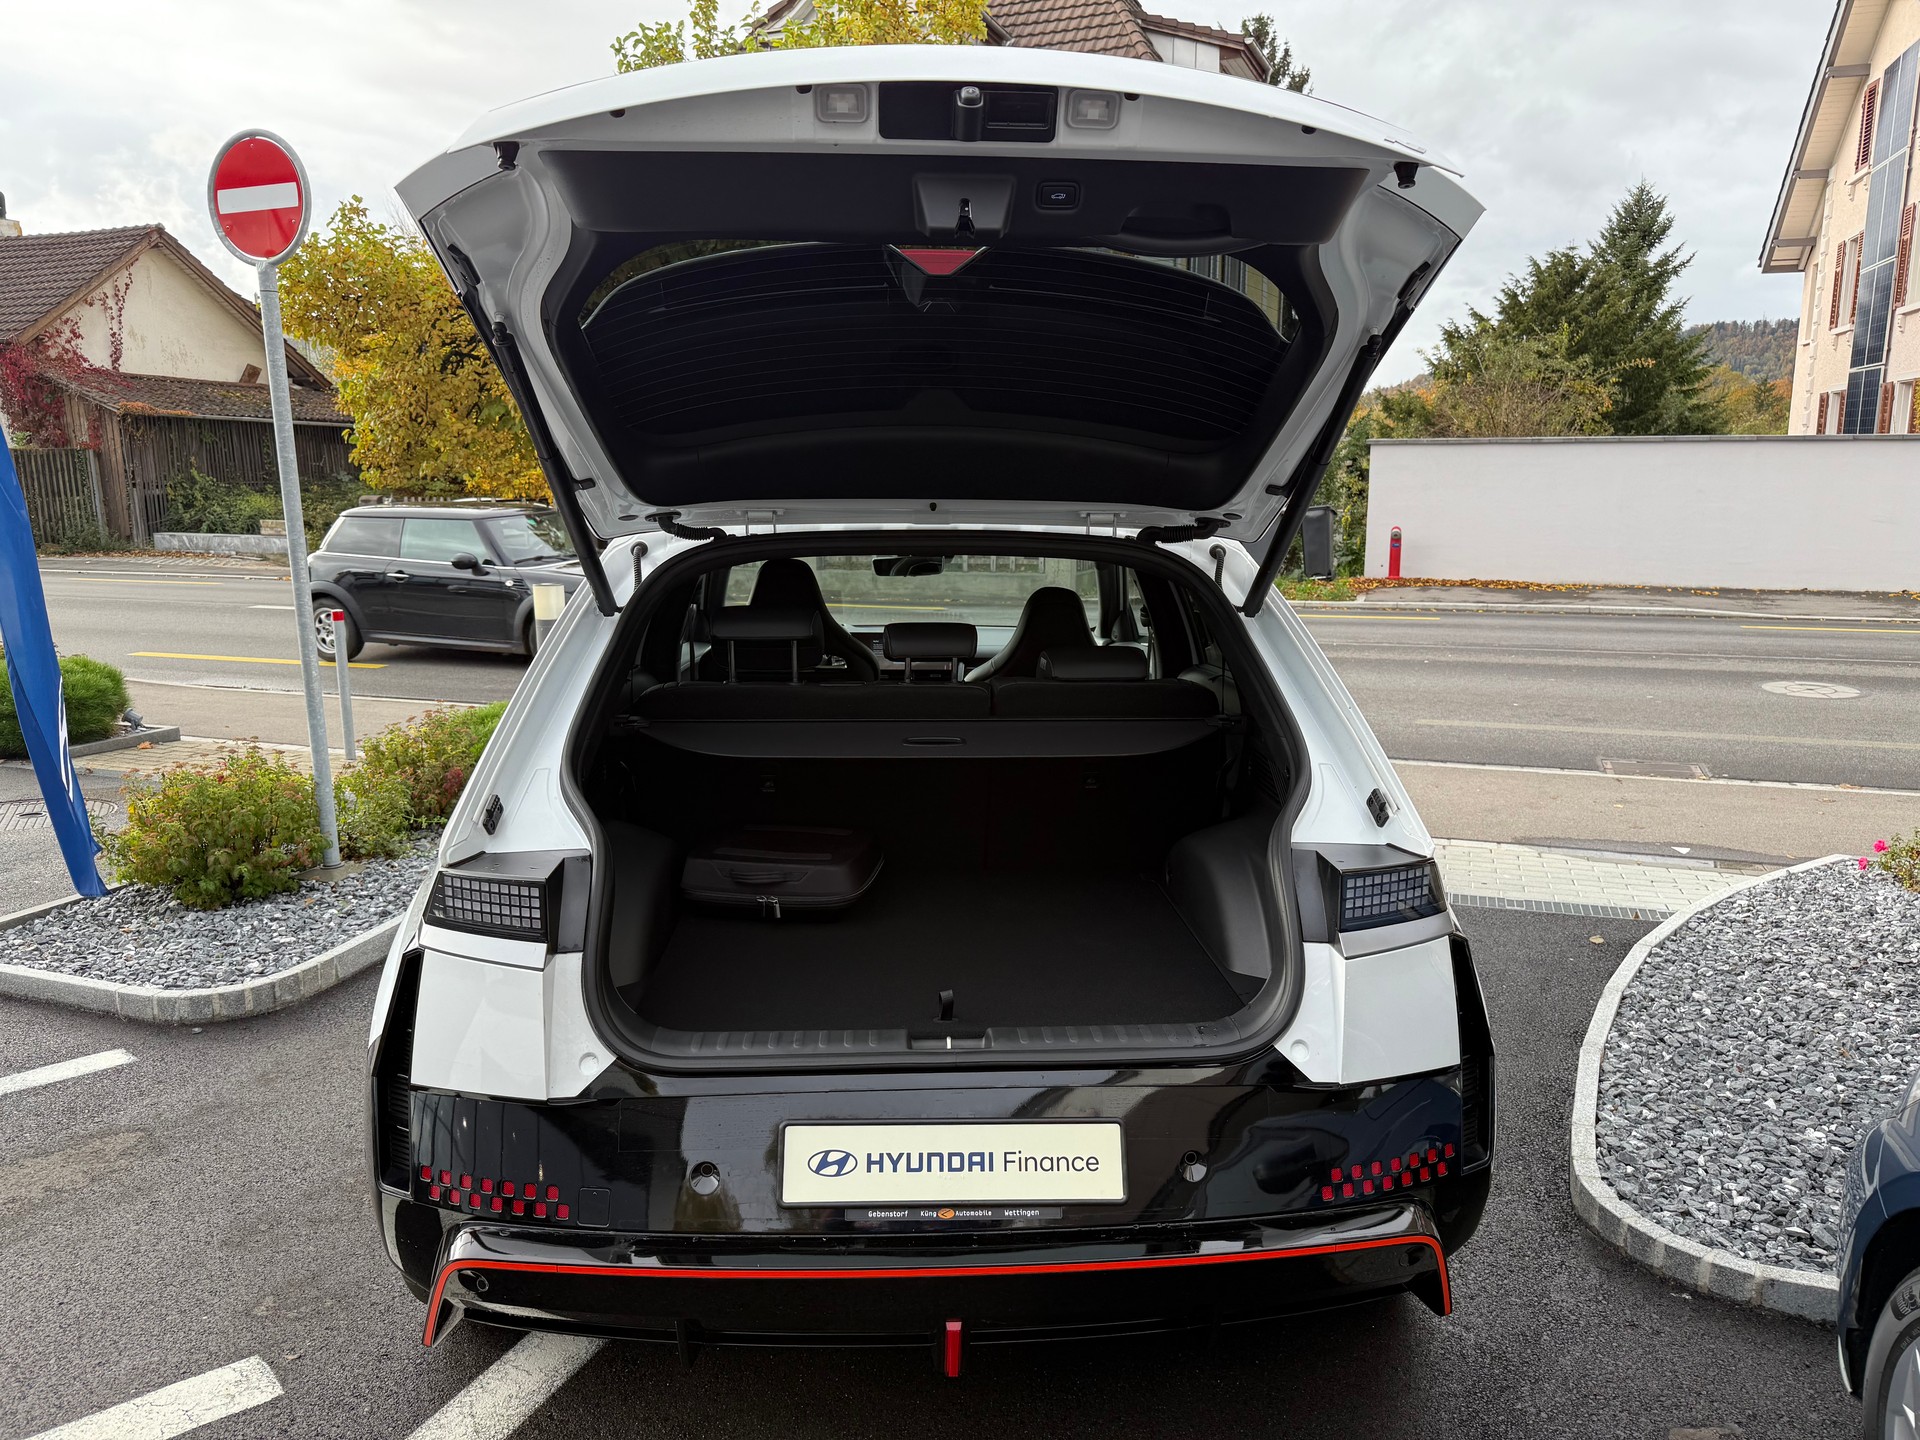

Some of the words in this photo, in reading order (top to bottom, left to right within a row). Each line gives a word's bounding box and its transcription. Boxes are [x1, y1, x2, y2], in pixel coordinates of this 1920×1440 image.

[866, 1152, 994, 1173] HYUNDAI
[1003, 1151, 1100, 1172] Finance
[868, 1210, 909, 1218] Gebenstorf
[920, 1210, 937, 1218] Küng
[955, 1209, 992, 1217] Automobile
[1004, 1209, 1040, 1217] Wettingen
